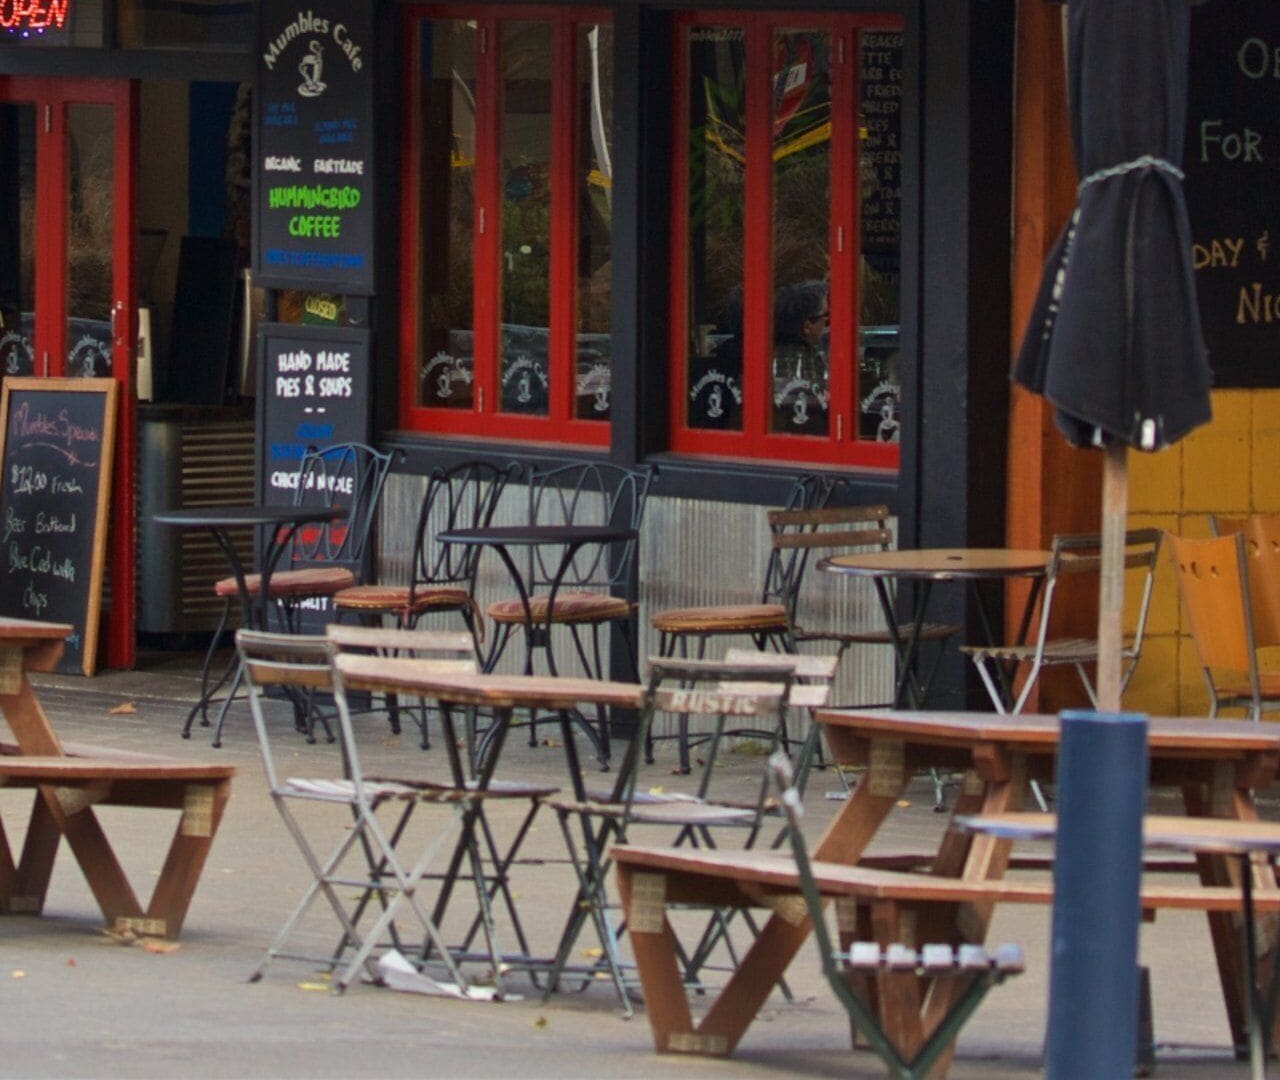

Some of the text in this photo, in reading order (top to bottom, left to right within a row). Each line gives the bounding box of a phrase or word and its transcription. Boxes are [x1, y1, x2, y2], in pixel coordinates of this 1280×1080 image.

[263, 10, 363, 72] Mumbles Cafe
[314, 158, 364, 176] FAIRTRADE
[269, 184, 360, 210] HUMMINGBIRD
[288, 216, 341, 238] COFFEE
[278, 350, 351, 373] HAND MADE
[276, 375, 353, 398] PIES & SOUPS
[671, 691, 757, 714] RUSTIC
